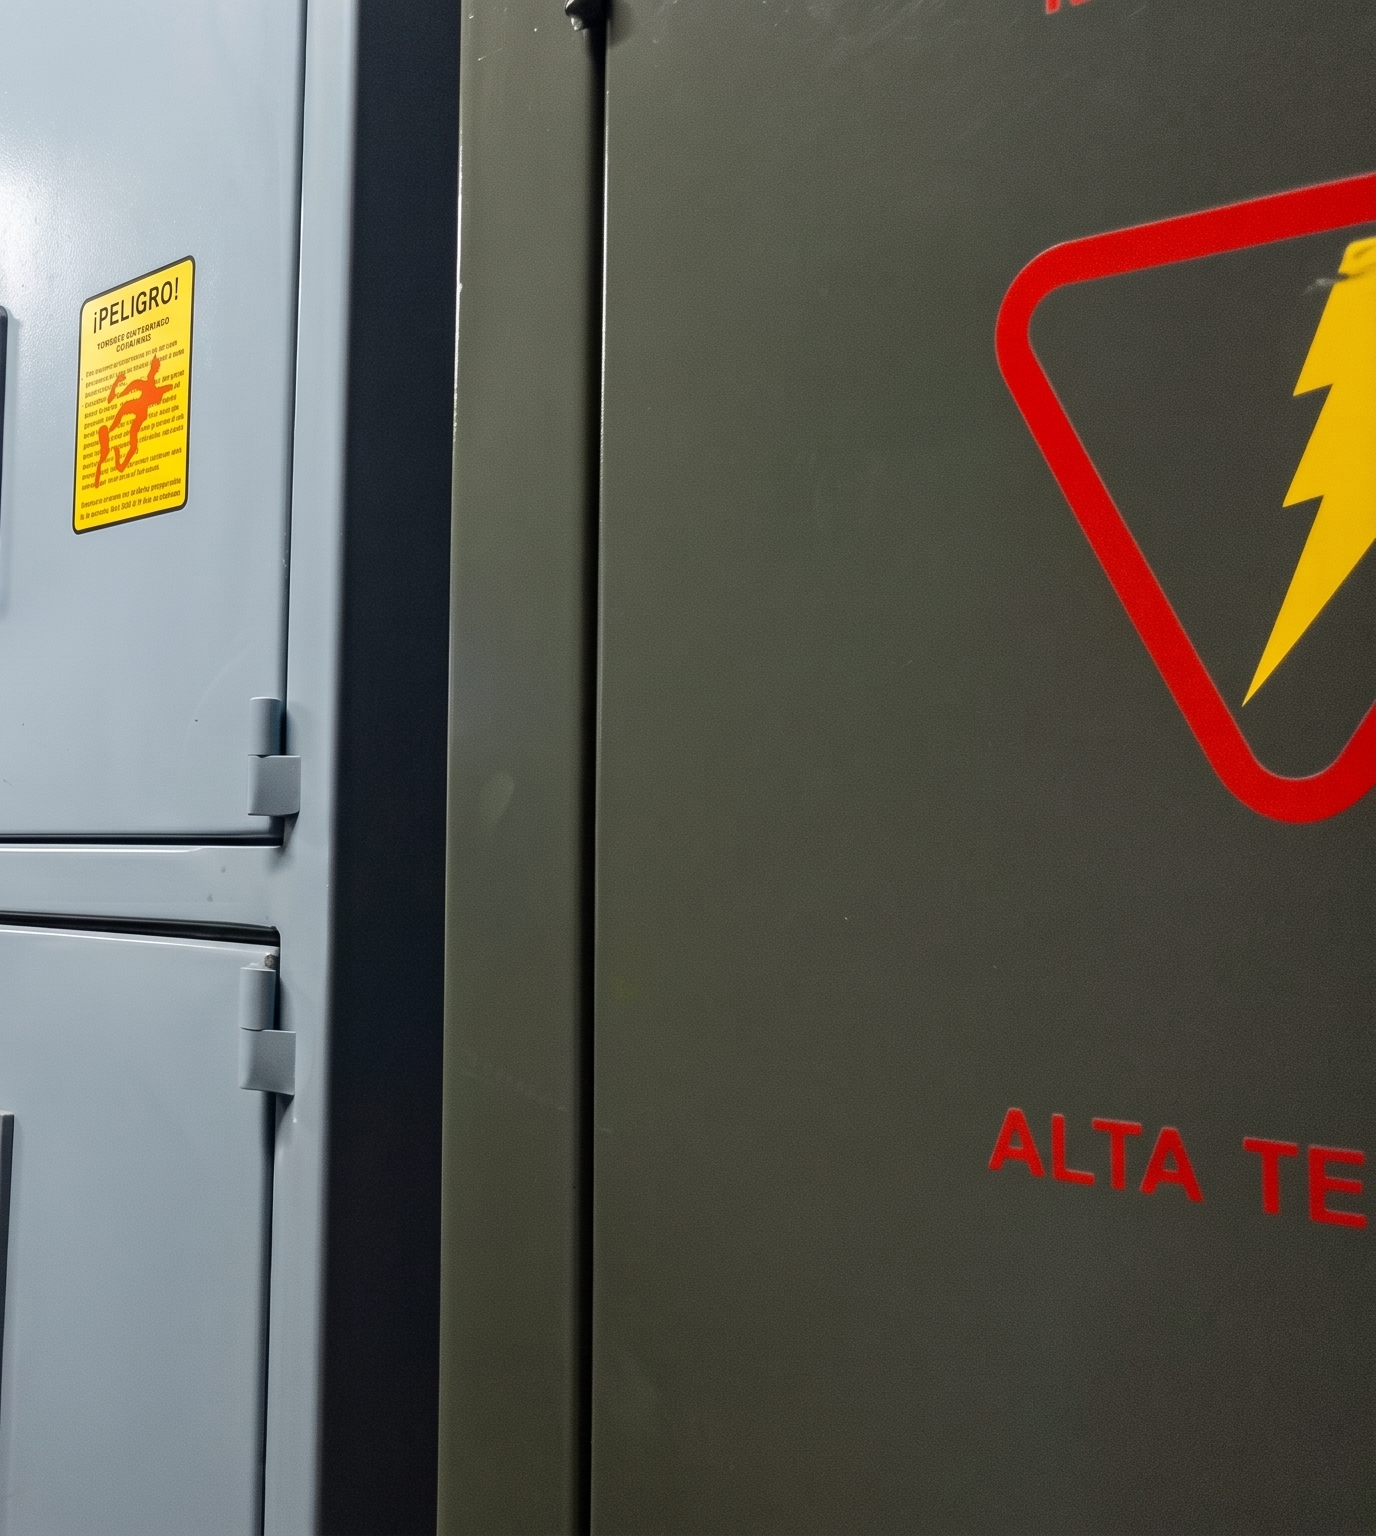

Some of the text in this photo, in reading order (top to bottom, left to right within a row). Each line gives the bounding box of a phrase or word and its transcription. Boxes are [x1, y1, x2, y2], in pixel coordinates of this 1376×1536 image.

[93, 277, 179, 334] ¡PELIGRO!
[988, 1107, 1367, 1230] ALTA TE
